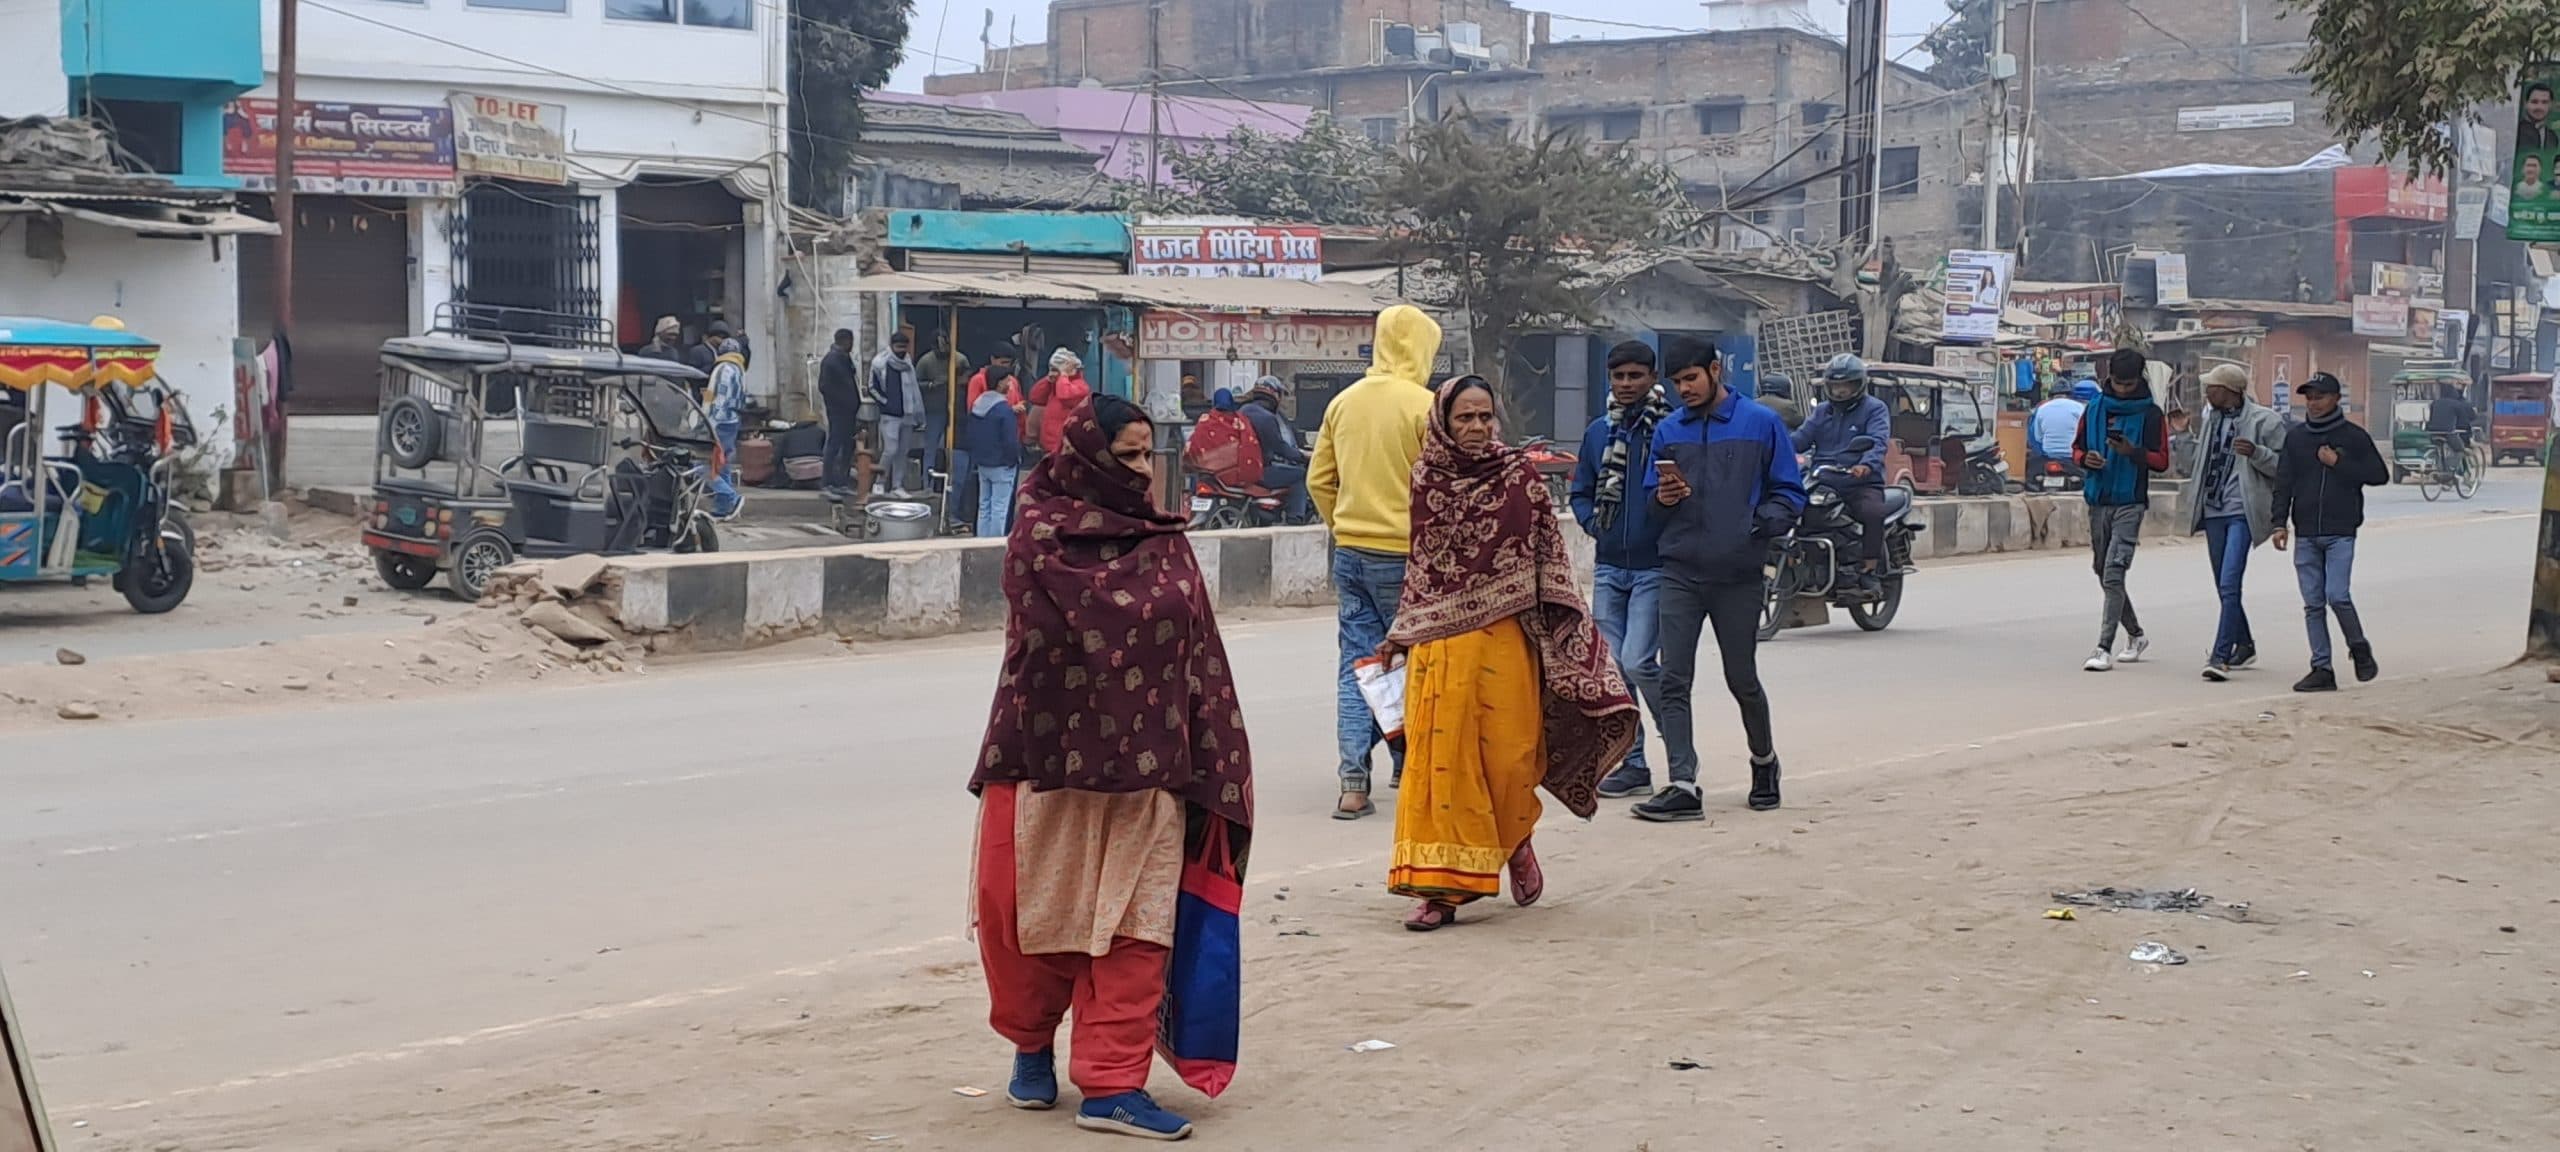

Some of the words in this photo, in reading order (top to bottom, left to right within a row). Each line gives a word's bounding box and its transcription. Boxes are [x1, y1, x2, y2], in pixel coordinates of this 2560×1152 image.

[474, 95, 539, 122] TO-LET
[350, 111, 431, 138] सिस्टर्स
[1136, 234, 1200, 260] राजन
[1206, 227, 1275, 260] प्रिंटिंग
[1279, 228, 1318, 261] प्रेस
